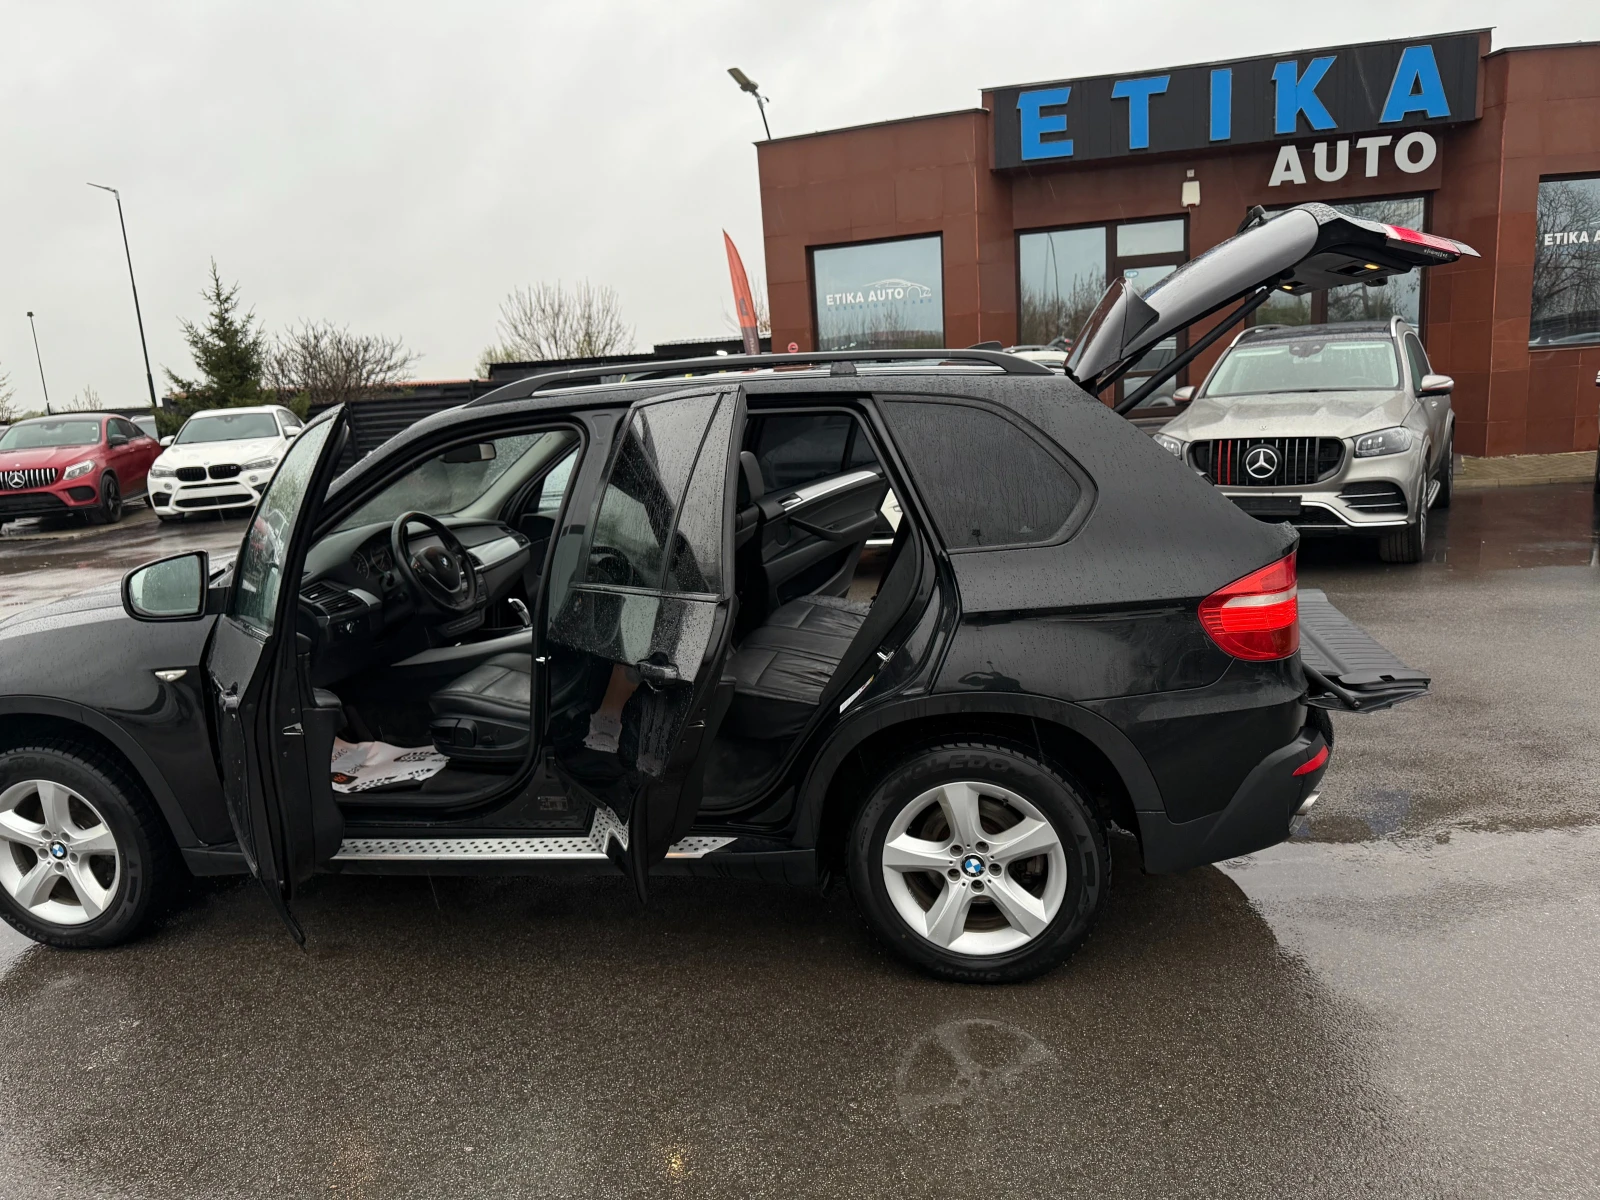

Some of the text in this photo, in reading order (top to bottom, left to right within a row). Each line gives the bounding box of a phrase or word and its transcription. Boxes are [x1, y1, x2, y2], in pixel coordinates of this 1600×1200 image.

[1016, 44, 1451, 162] ETIKA
[1267, 131, 1438, 188] AUTO
[1544, 230, 1590, 246] ETIKA
[826, 287, 904, 306] ETIKA AUTO
